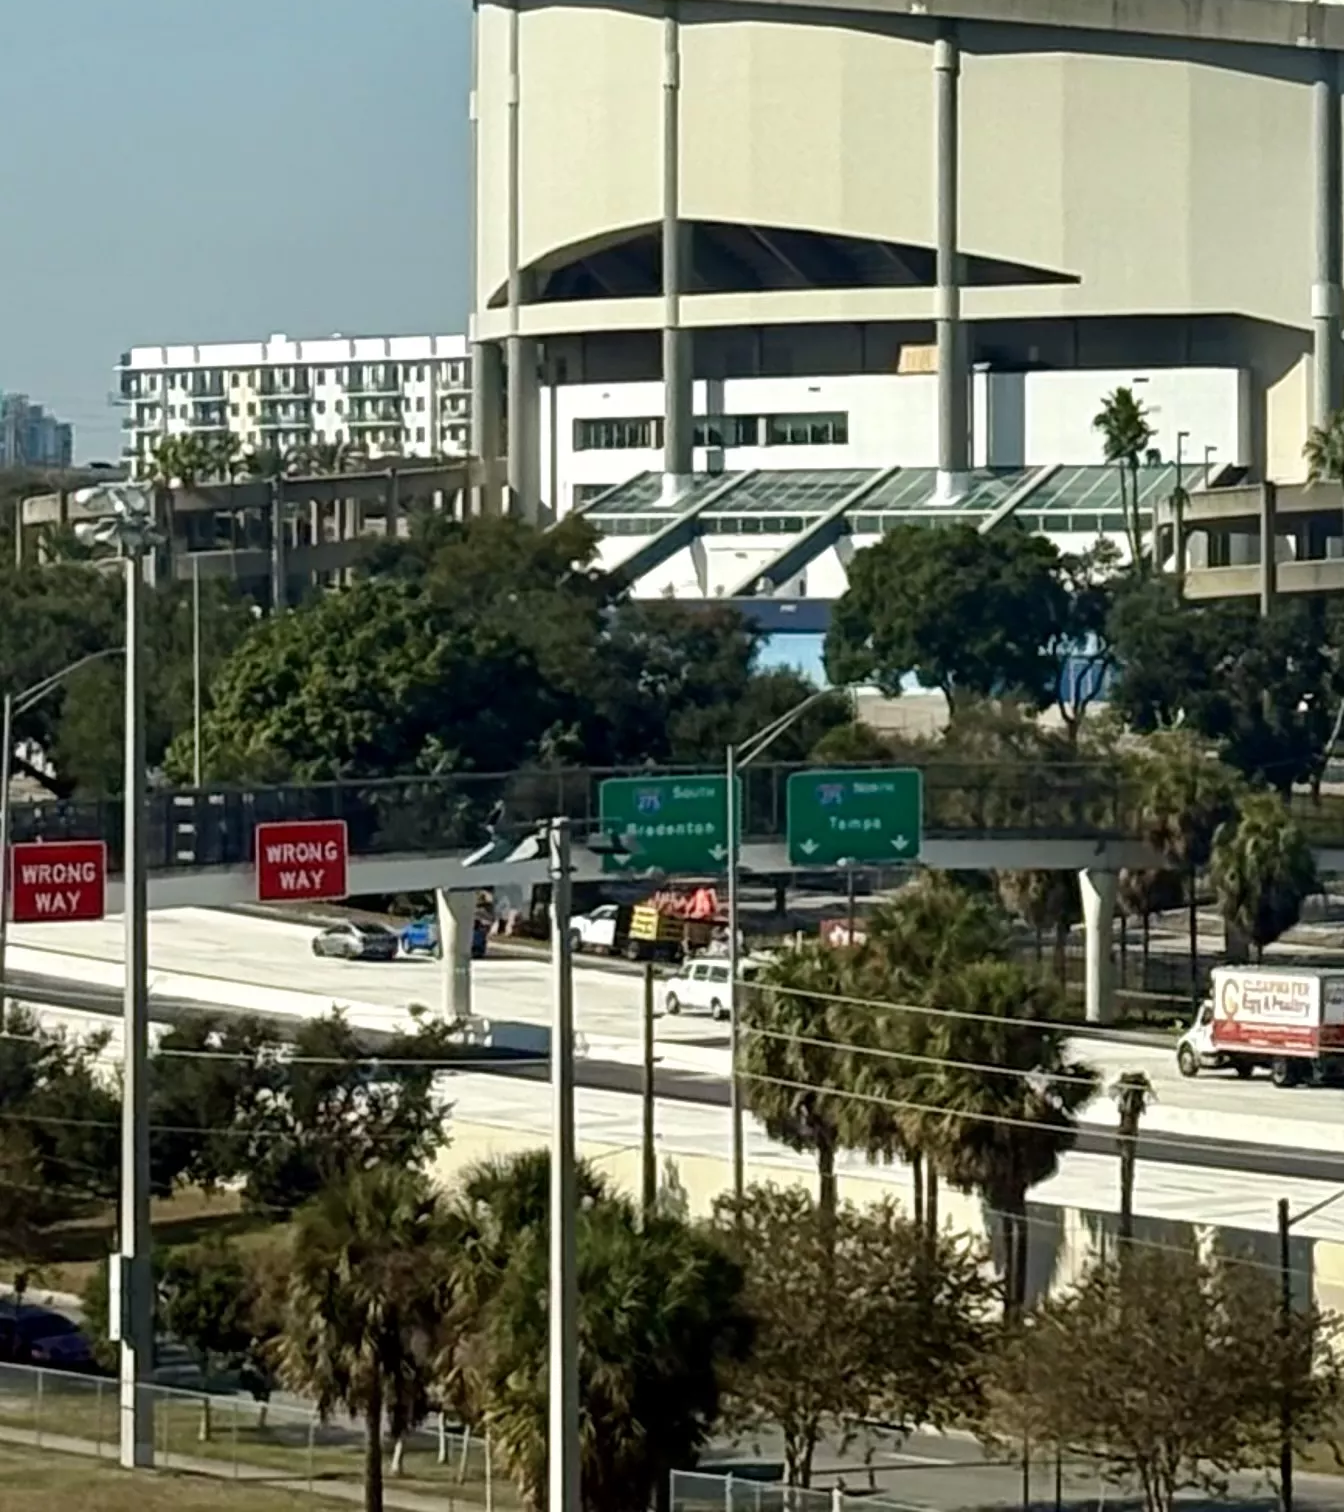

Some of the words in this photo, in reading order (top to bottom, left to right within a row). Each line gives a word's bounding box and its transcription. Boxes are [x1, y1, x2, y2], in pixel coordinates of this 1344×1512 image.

[828, 815, 882, 831] Tampa
[265, 840, 339, 864] WRONG
[21, 861, 97, 885] WRONG
[279, 868, 325, 890] WAY
[34, 889, 82, 913] WAY
